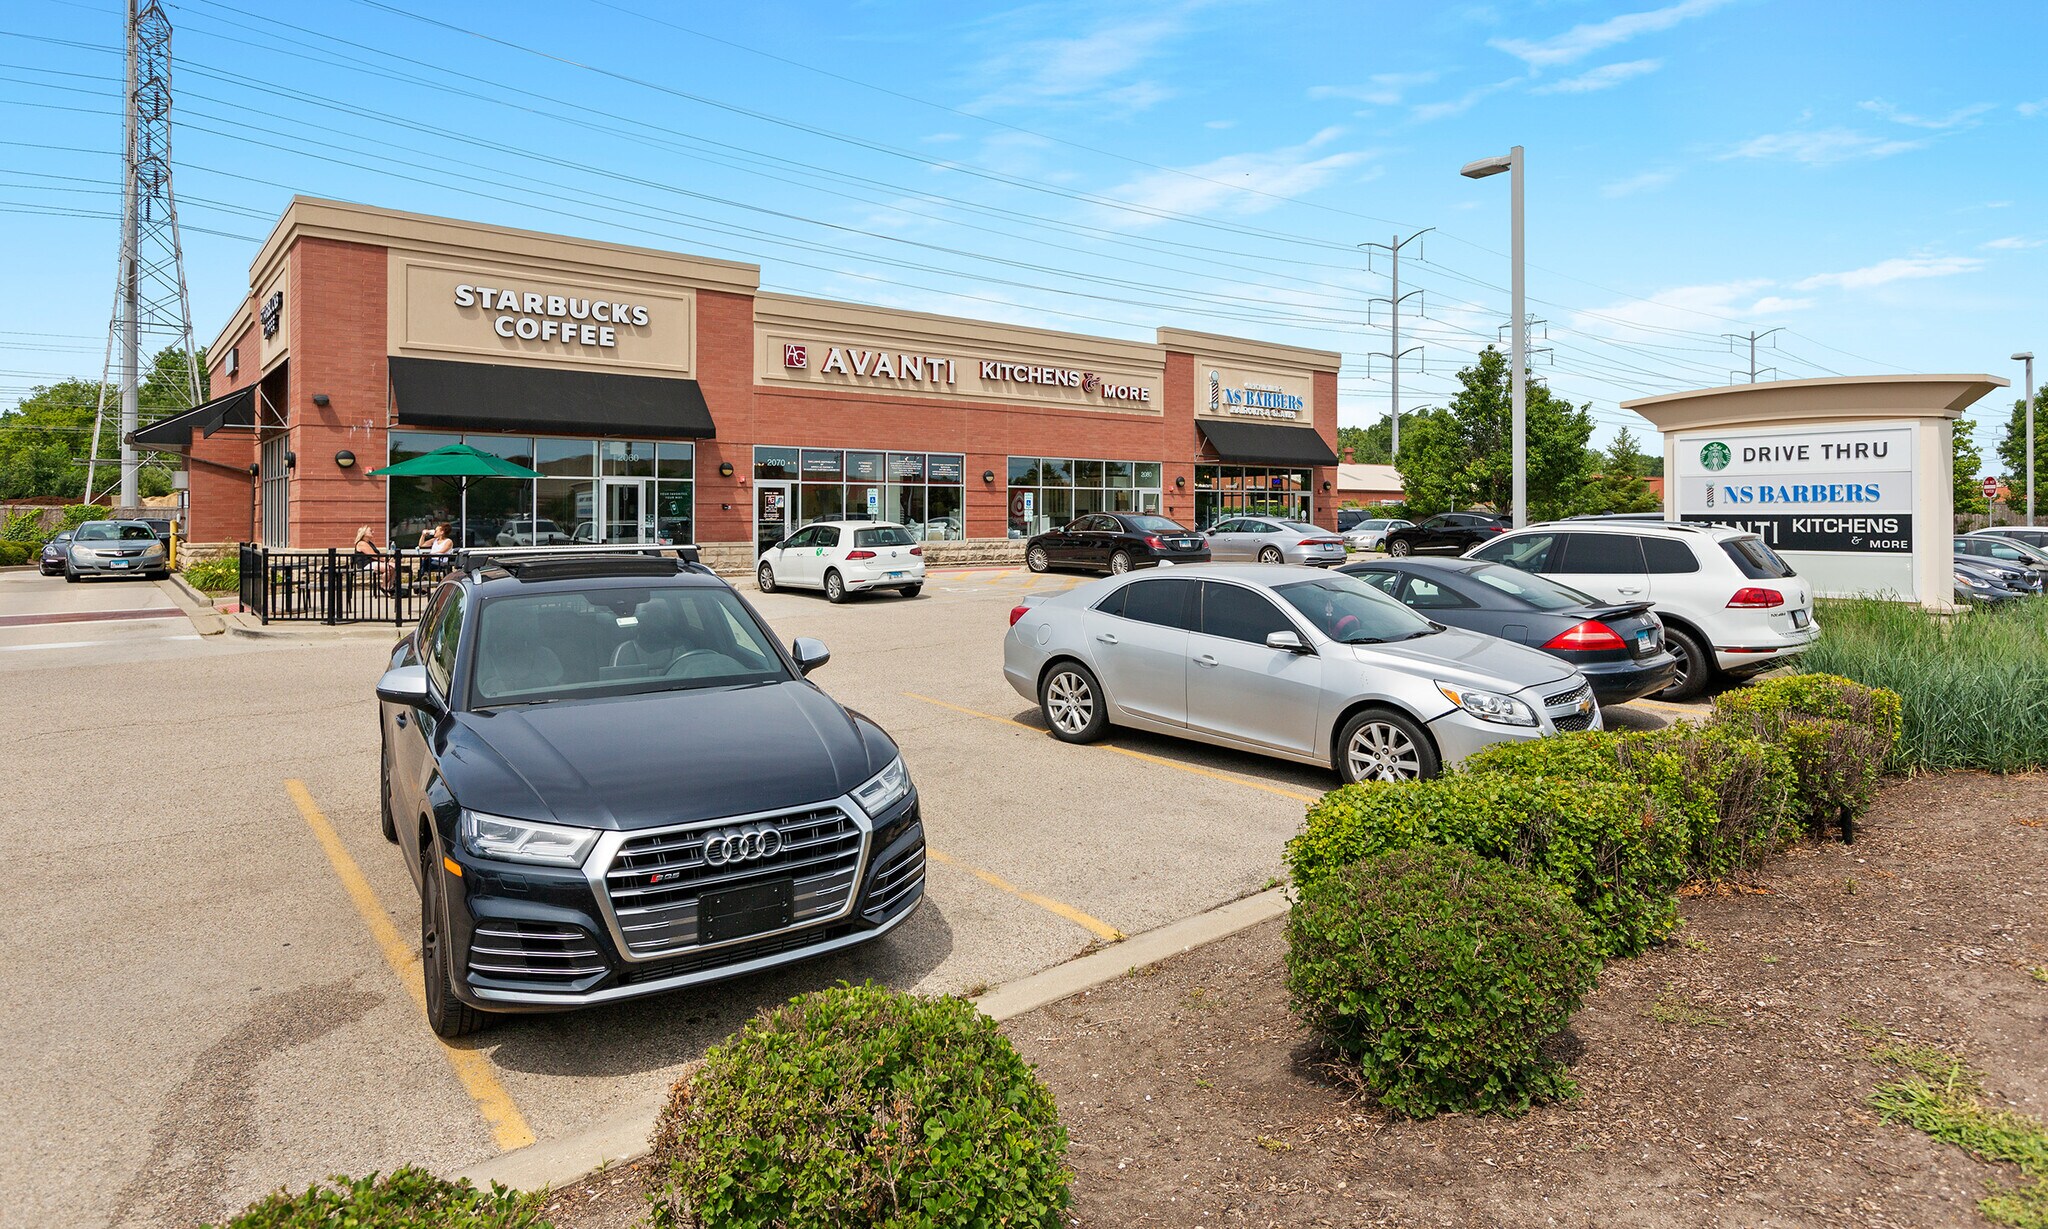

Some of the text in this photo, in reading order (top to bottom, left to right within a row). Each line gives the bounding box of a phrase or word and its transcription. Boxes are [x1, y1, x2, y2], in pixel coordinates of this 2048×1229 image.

[455, 284, 649, 326] STARBUCKS
[494, 315, 615, 347] COFFEE
[821, 347, 955, 384] AVANTI
[979, 360, 1150, 401] KITCHENS & MORE
[1222, 388, 1242, 405] NS
[1243, 390, 1304, 411] BARBERS
[618, 454, 639, 462] 2060
[767, 458, 786, 467] 2070
[1743, 442, 1888, 462] DRIVE THRU
[1723, 483, 1881, 504] NS BARBERS
[1792, 518, 1899, 534] KITCHENS
[1851, 536, 1863, 545] &
[1869, 540, 1908, 549] MORE
